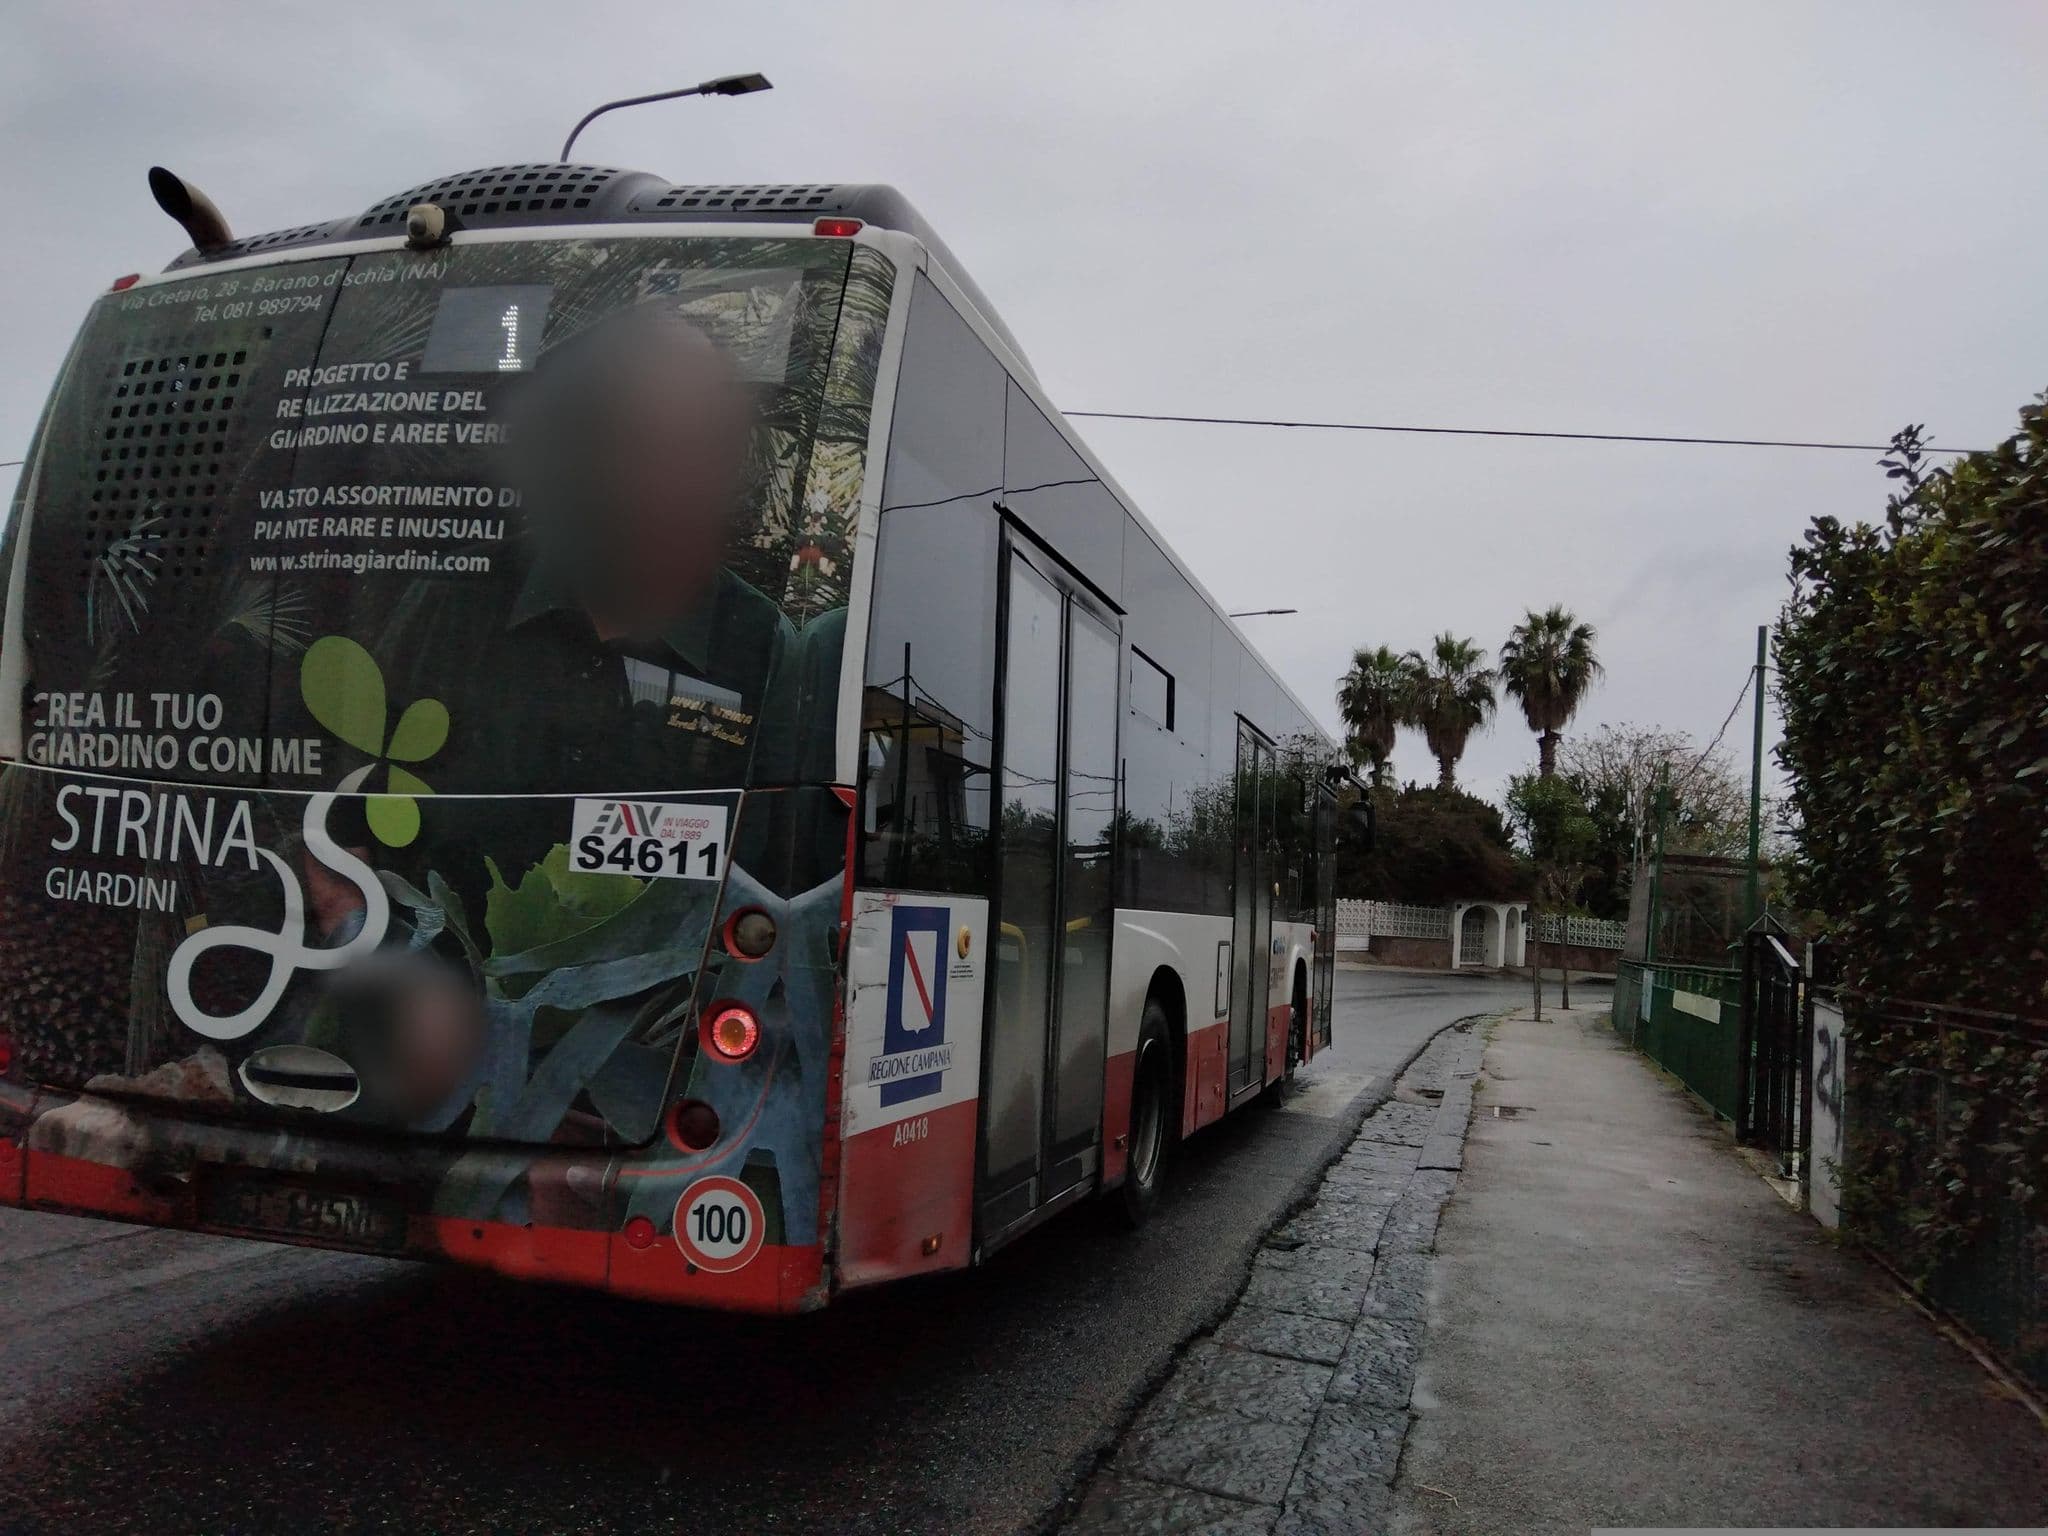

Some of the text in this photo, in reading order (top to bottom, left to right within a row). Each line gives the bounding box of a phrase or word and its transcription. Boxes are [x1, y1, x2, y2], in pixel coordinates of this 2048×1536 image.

[121, 296, 143, 311] Via
[217, 281, 240, 297] 28
[252, 274, 319, 295] Barano
[323, 266, 394, 287] d'schia
[401, 262, 447, 283] (NA)
[194, 294, 323, 323] Tel. 081 989794
[498, 304, 522, 371] 1
[283, 361, 410, 388] PROGETTO E
[276, 391, 488, 418] REALIZZAZIONE DEL
[269, 423, 368, 450] GIARDINO
[372, 423, 387, 444] E
[390, 423, 449, 444] AREE
[259, 487, 319, 509] VASTO
[321, 485, 494, 508] ASSORTIMENTO
[254, 517, 505, 540] PIANTE RARE E INUSUALI
[249, 549, 491, 574] www.strinagiardini.com
[33, 692, 224, 731] CREA IL TUO
[27, 732, 322, 775] GIARDINO CON ME
[50, 784, 259, 871] STRINA
[660, 828, 676, 838] DAL
[663, 817, 710, 829] IN VIAGGIO
[577, 835, 718, 877] S4611
[45, 866, 177, 913] GIARDINI
[870, 1048, 951, 1081] REGIONE CAMPANIA
[892, 1116, 929, 1148] A0418
[692, 1204, 746, 1244] 100
